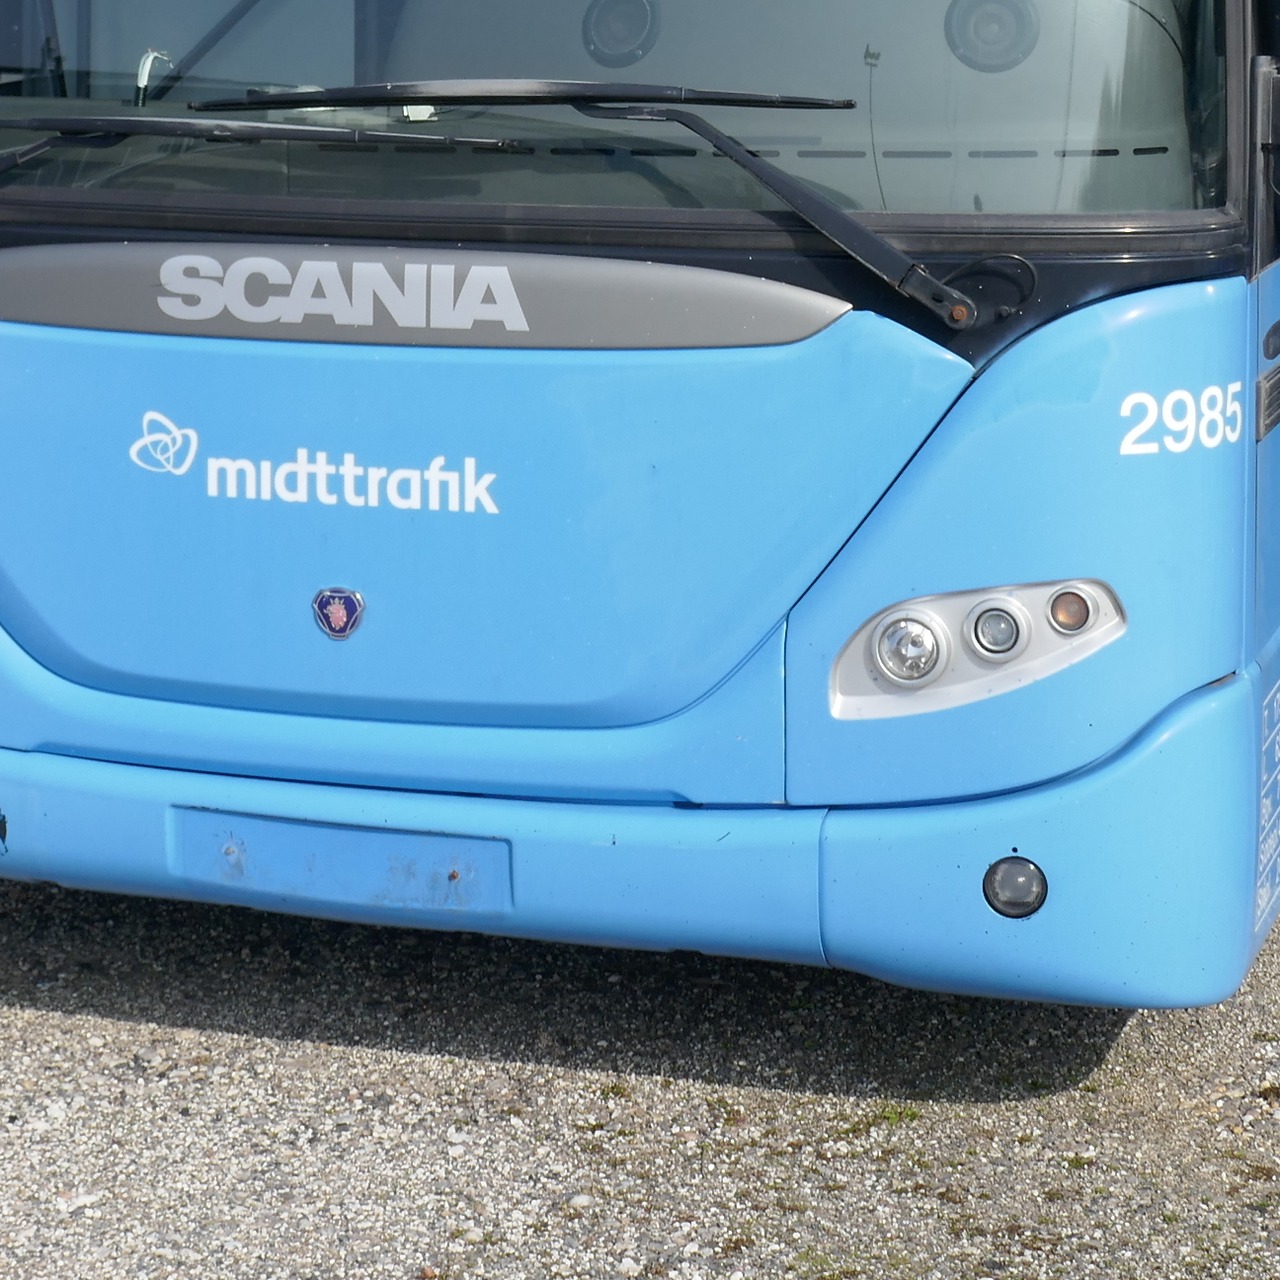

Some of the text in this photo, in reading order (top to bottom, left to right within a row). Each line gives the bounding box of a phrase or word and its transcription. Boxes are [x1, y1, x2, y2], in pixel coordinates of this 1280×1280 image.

[156, 253, 530, 332] SCANIA
[1119, 380, 1242, 456] 2985
[206, 447, 500, 515] midttrafik
